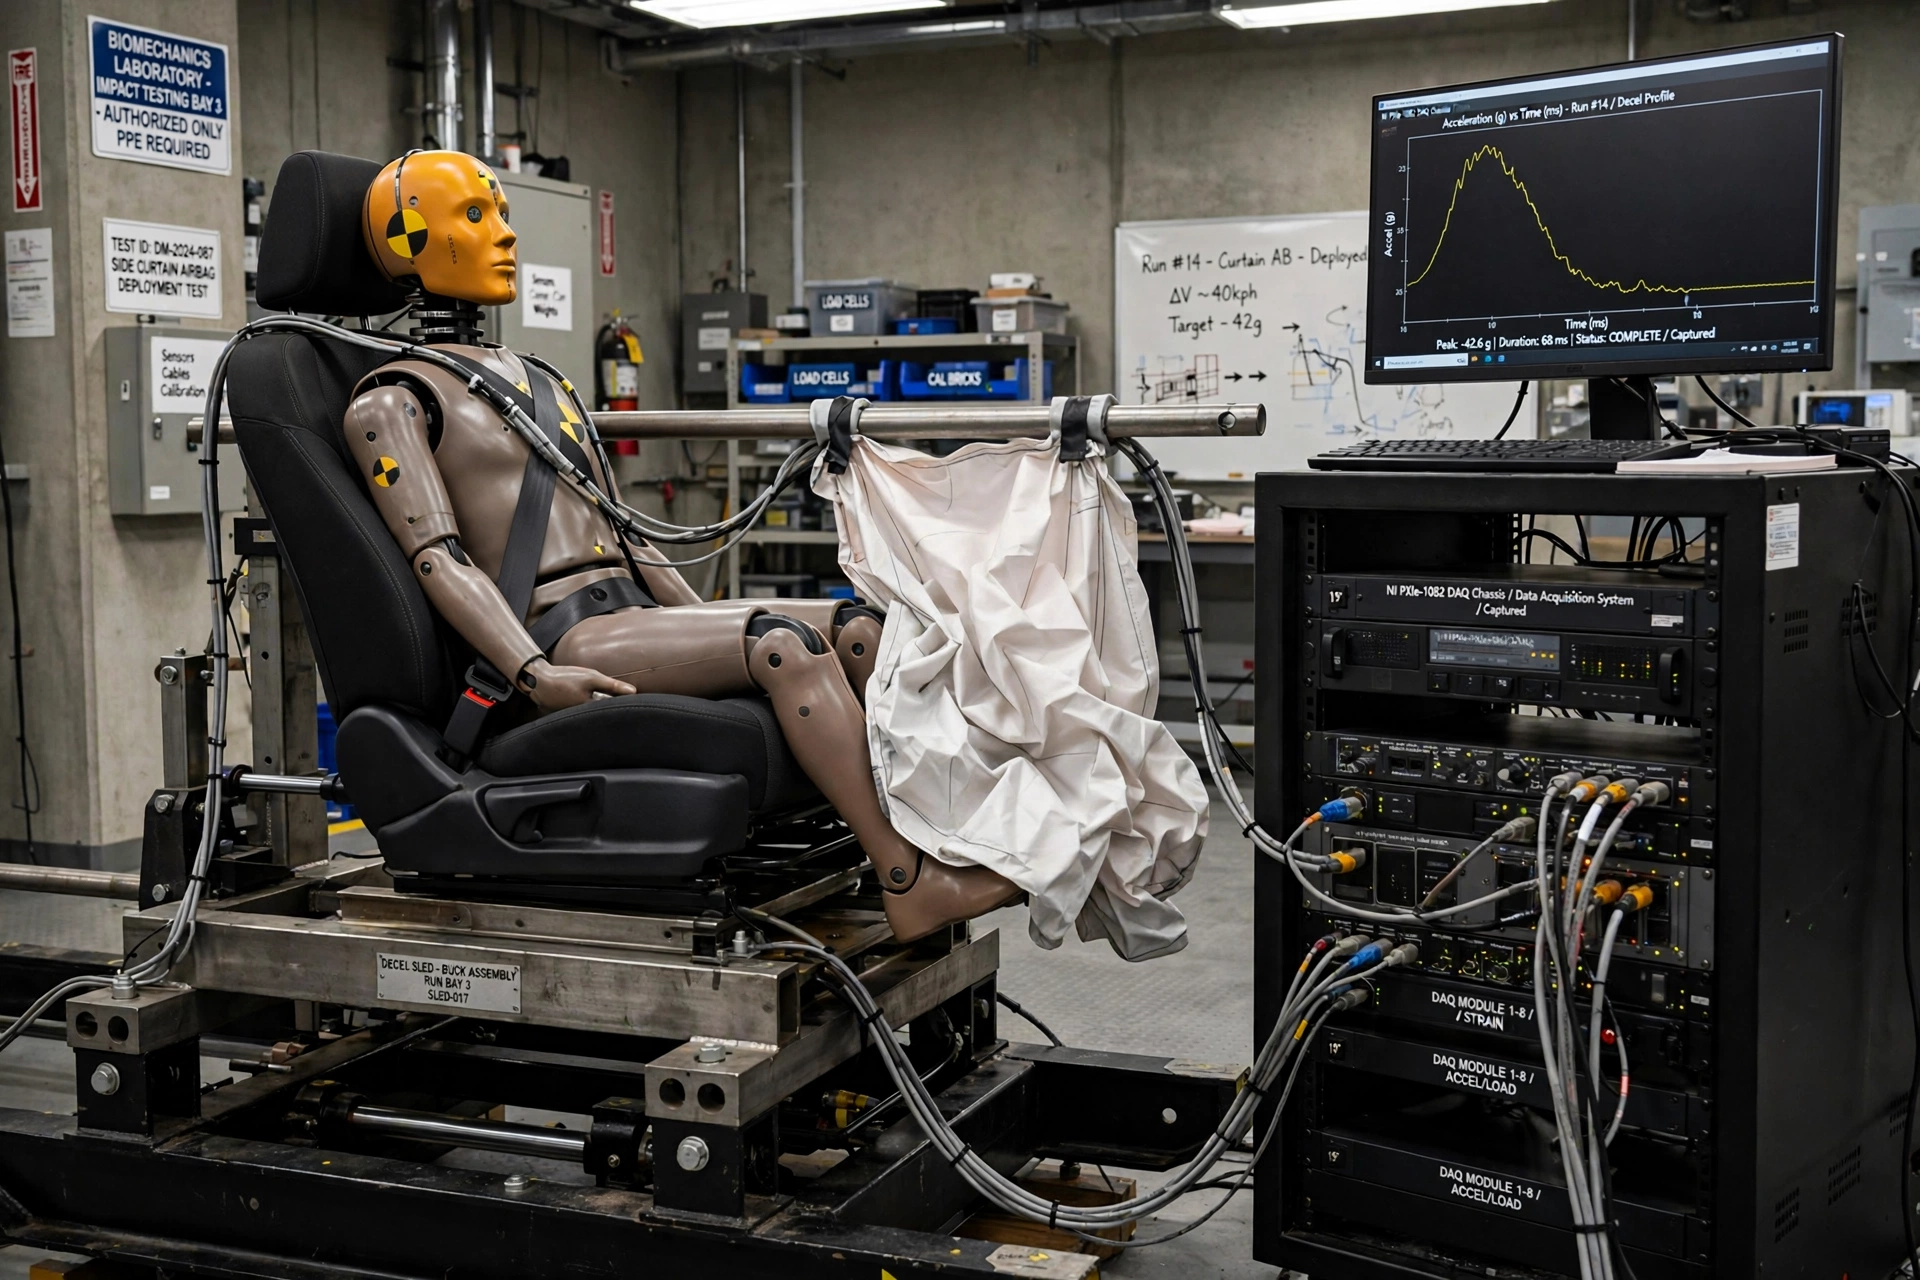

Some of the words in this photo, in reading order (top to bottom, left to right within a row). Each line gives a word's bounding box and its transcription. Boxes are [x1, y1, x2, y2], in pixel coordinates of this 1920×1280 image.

[108, 30, 211, 69] BIOMECHANICS
[114, 55, 203, 88] LABORATORY
[96, 76, 140, 99] IMPACT
[142, 85, 189, 108] TESTING
[192, 94, 213, 112] BAY
[104, 104, 188, 134] AUTHORIZED
[192, 120, 223, 140] ONLY
[1442, 114, 1493, 129] Acceleration
[1495, 110, 1507, 125] (g)
[1509, 111, 1518, 121] vs
[1520, 107, 1542, 120] Time
[1544, 104, 1563, 119] (ms)
[1571, 102, 1589, 114] Run
[1591, 98, 1608, 110] #14
[1618, 93, 1642, 107] Decel
[1644, 90, 1675, 103] Profile
[117, 130, 142, 150] PPE
[146, 134, 210, 160] REQUIRED
[1385, 211, 1396, 226] (g)
[111, 236, 136, 253] TEST
[1384, 229, 1393, 257] Accel
[112, 257, 134, 273] SIDE
[137, 260, 178, 277] CURTAIN
[1142, 254, 1167, 274] Run
[1172, 253, 1200, 271] #14
[1218, 251, 1265, 270] Curtain
[1271, 248, 1292, 266] AB
[1311, 246, 1367, 270] Deployed
[118, 277, 183, 296] DEPLOYMENT
[186, 283, 208, 298] TEST
[822, 294, 843, 309] LOAD
[844, 294, 870, 308] CELLS
[1168, 315, 1214, 340] Target
[1232, 313, 1262, 338] 42g
[1564, 318, 1587, 330] Time
[1589, 316, 1608, 331] (ms)
[1485, 342, 1492, 351] g
[1499, 336, 1539, 348] Duration:
[1541, 335, 1553, 346] 68
[1555, 337, 1568, 345] ms
[1608, 330, 1662, 343] COMPLETE
[1670, 326, 1716, 343] Captured
[794, 371, 820, 385] LOAD
[822, 370, 850, 385] CELLS
[928, 372, 947, 386] CAL
[1386, 584, 1398, 596] NI
[1448, 586, 1470, 600] DAQ
[1472, 587, 1506, 600] Chassis
[1516, 590, 1538, 602] Data
[1540, 590, 1595, 606] Acquisition
[1597, 592, 1634, 608] System
[1484, 603, 1527, 618] Captured
[382, 958, 410, 972] DECEL
[412, 960, 434, 973] SLED
[442, 964, 466, 977] BUCK
[468, 967, 517, 982] ASSEMBLY
[424, 975, 443, 988] RUN
[446, 978, 463, 989] BAY
[466, 980, 471, 990] 3
[428, 990, 469, 1004] SLED-017
[1432, 992, 1456, 1008] DAQ
[1458, 996, 1505, 1015] MODULE
[1509, 1005, 1526, 1019] 1-8
[1464, 1012, 1504, 1032] STRAIN
[1433, 1054, 1456, 1070] DAQ
[1458, 1058, 1507, 1079] MODULE
[1510, 1069, 1527, 1082] 1-8
[1445, 1070, 1517, 1096] ACCEL/LOAD
[1440, 1166, 1463, 1183] DAQ
[1466, 1172, 1513, 1194] MODULE
[1516, 1184, 1534, 1199] 1-8
[1451, 1184, 1522, 1211] ACCEL/LOAD
